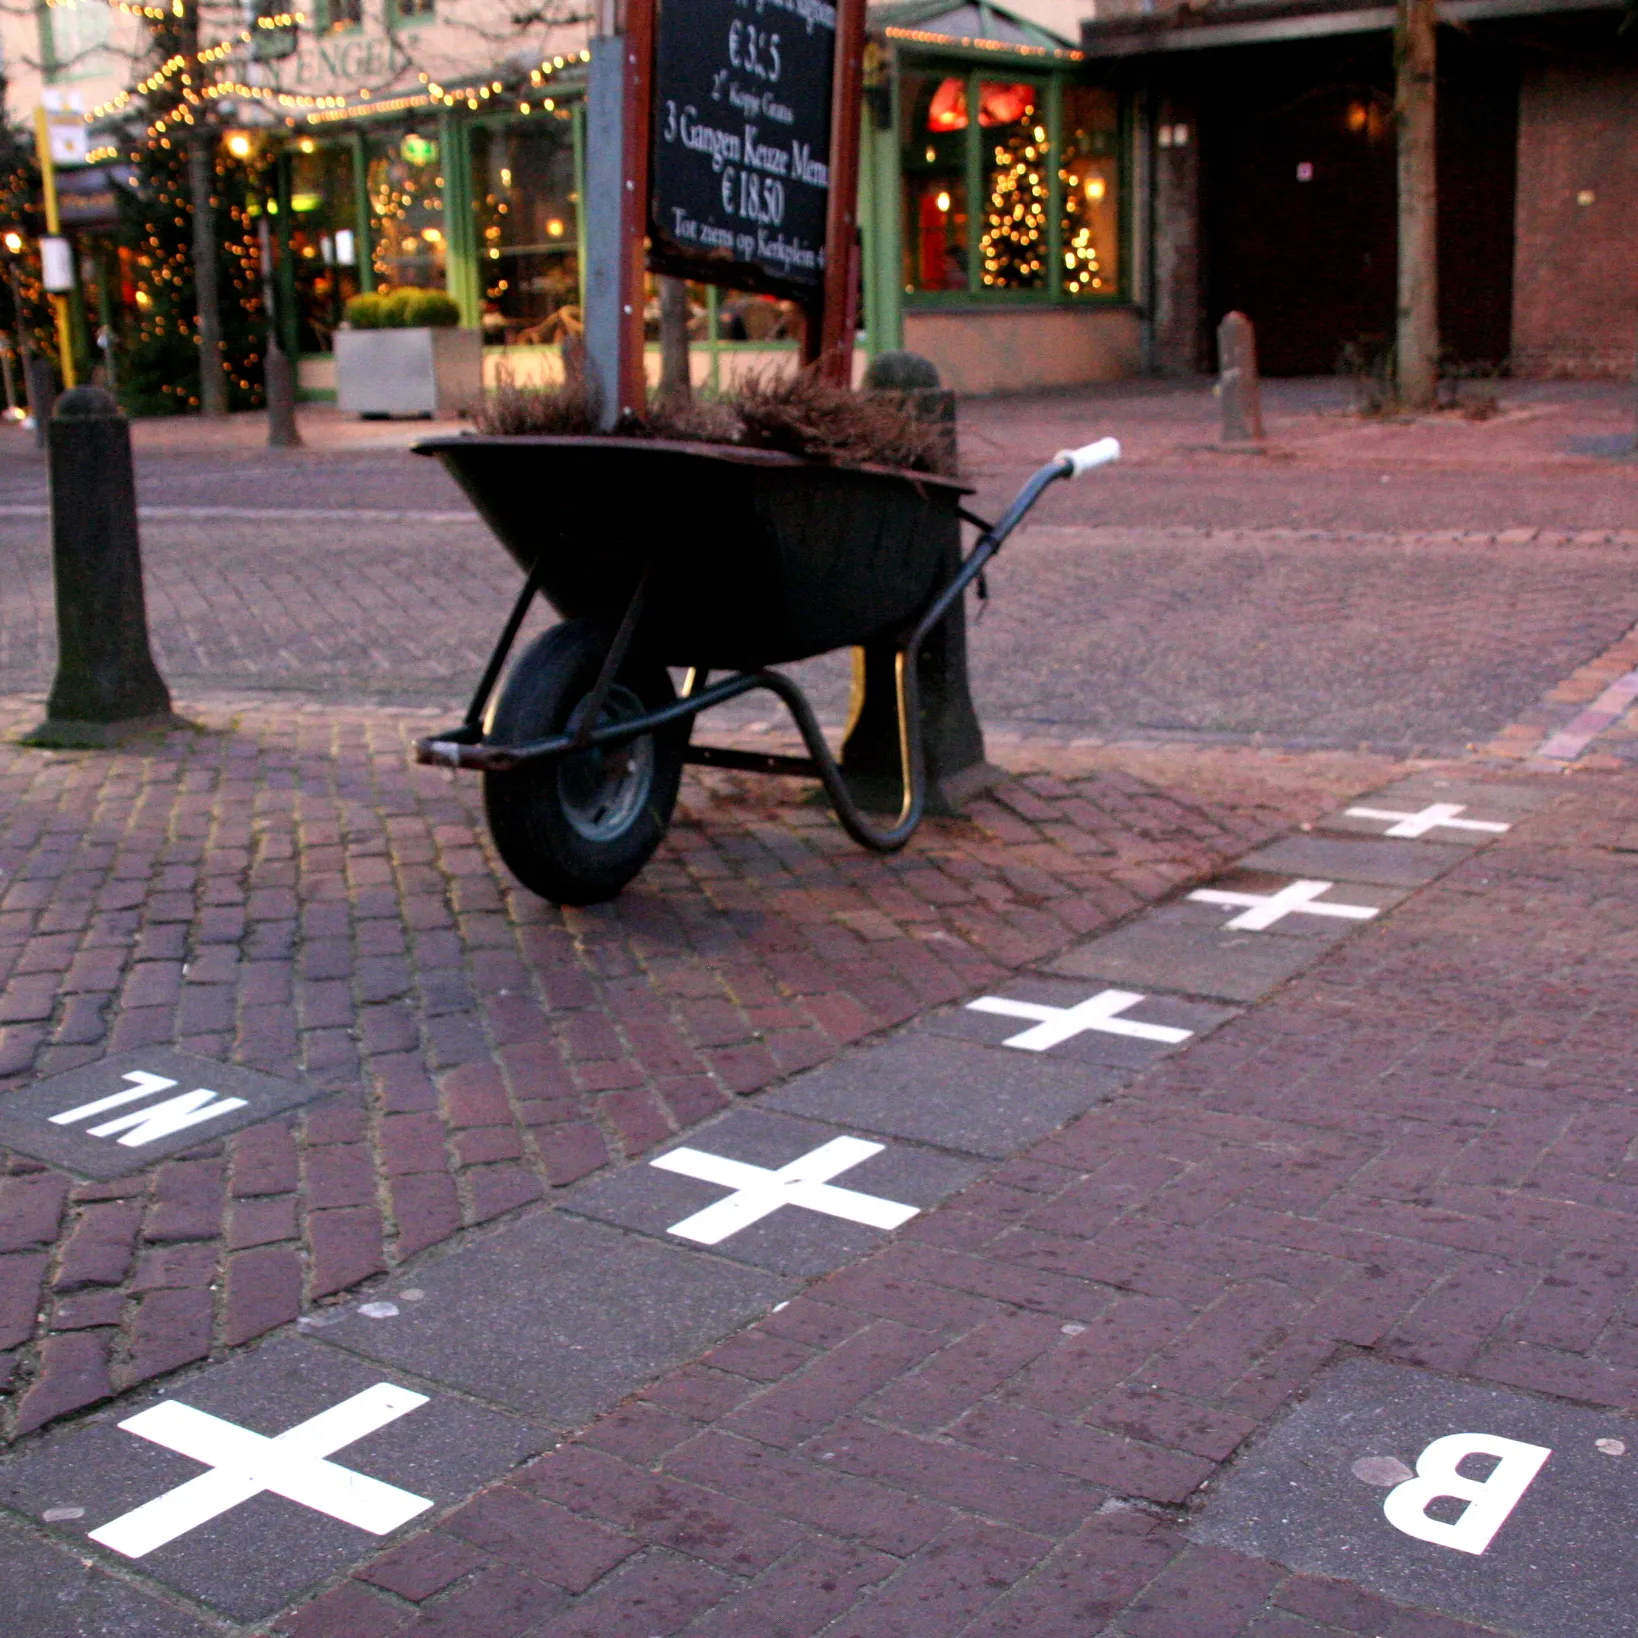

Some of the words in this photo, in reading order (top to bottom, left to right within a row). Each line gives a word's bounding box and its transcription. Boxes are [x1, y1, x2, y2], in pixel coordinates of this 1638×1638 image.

[663, 99, 678, 143] 3
[680, 104, 741, 173] Gangen
[744, 124, 790, 177] Keuze
[671, 206, 698, 240] Tot
[736, 233, 756, 262] op
[47, 1070, 248, 1147] NL
[1383, 1432, 1552, 1556] B
